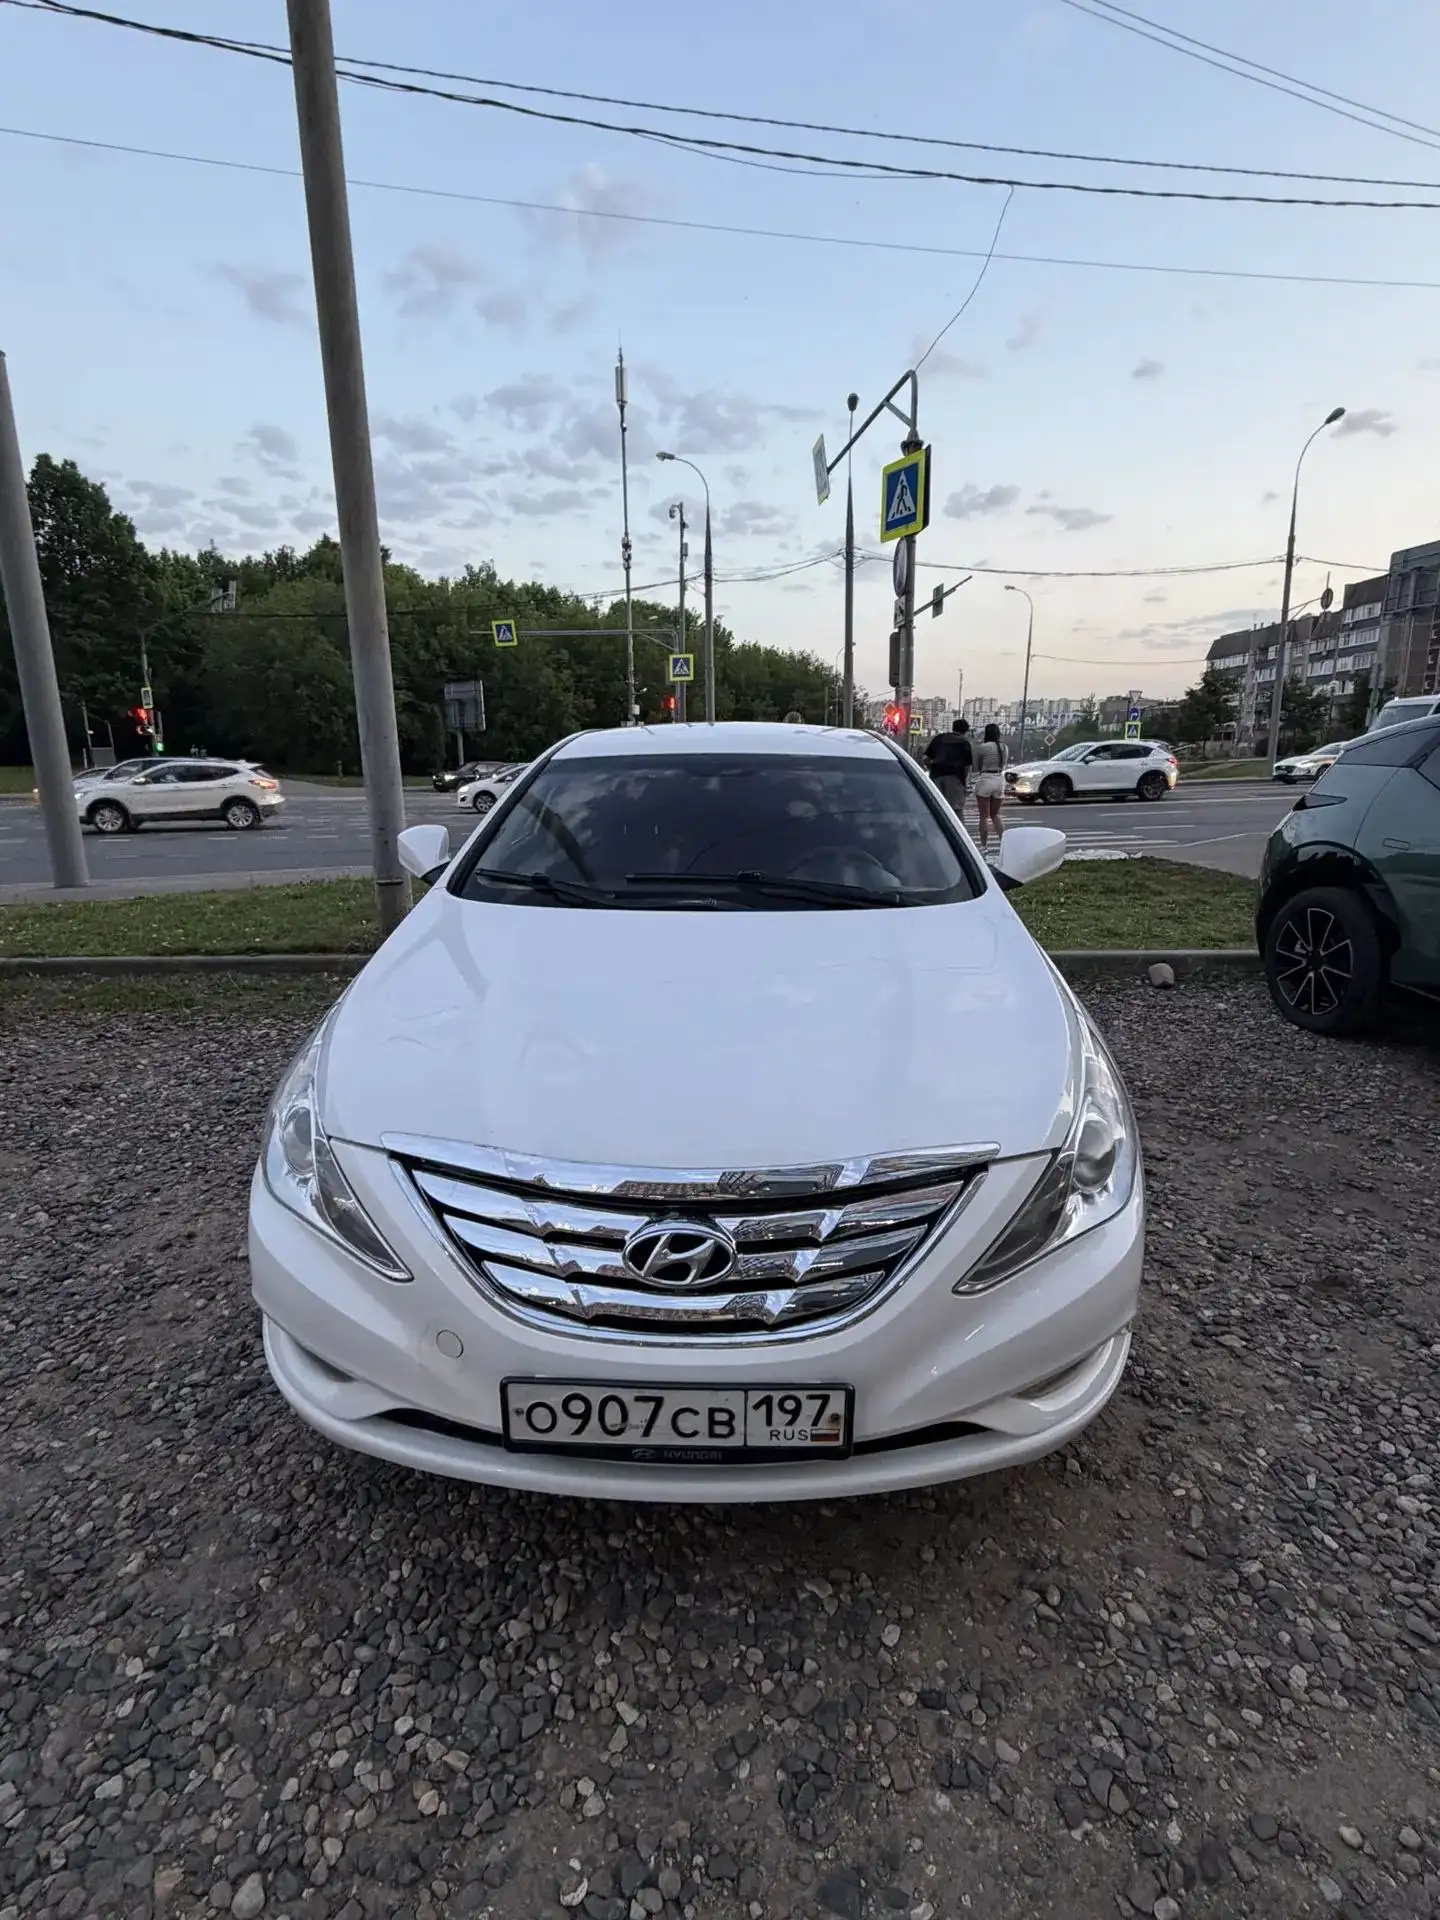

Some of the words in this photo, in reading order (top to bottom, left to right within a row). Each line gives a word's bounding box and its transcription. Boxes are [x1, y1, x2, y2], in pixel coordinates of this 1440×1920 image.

[525, 1392, 736, 1439] О907СВ
[752, 1394, 831, 1427] 197
[769, 1429, 809, 1441] RUS
